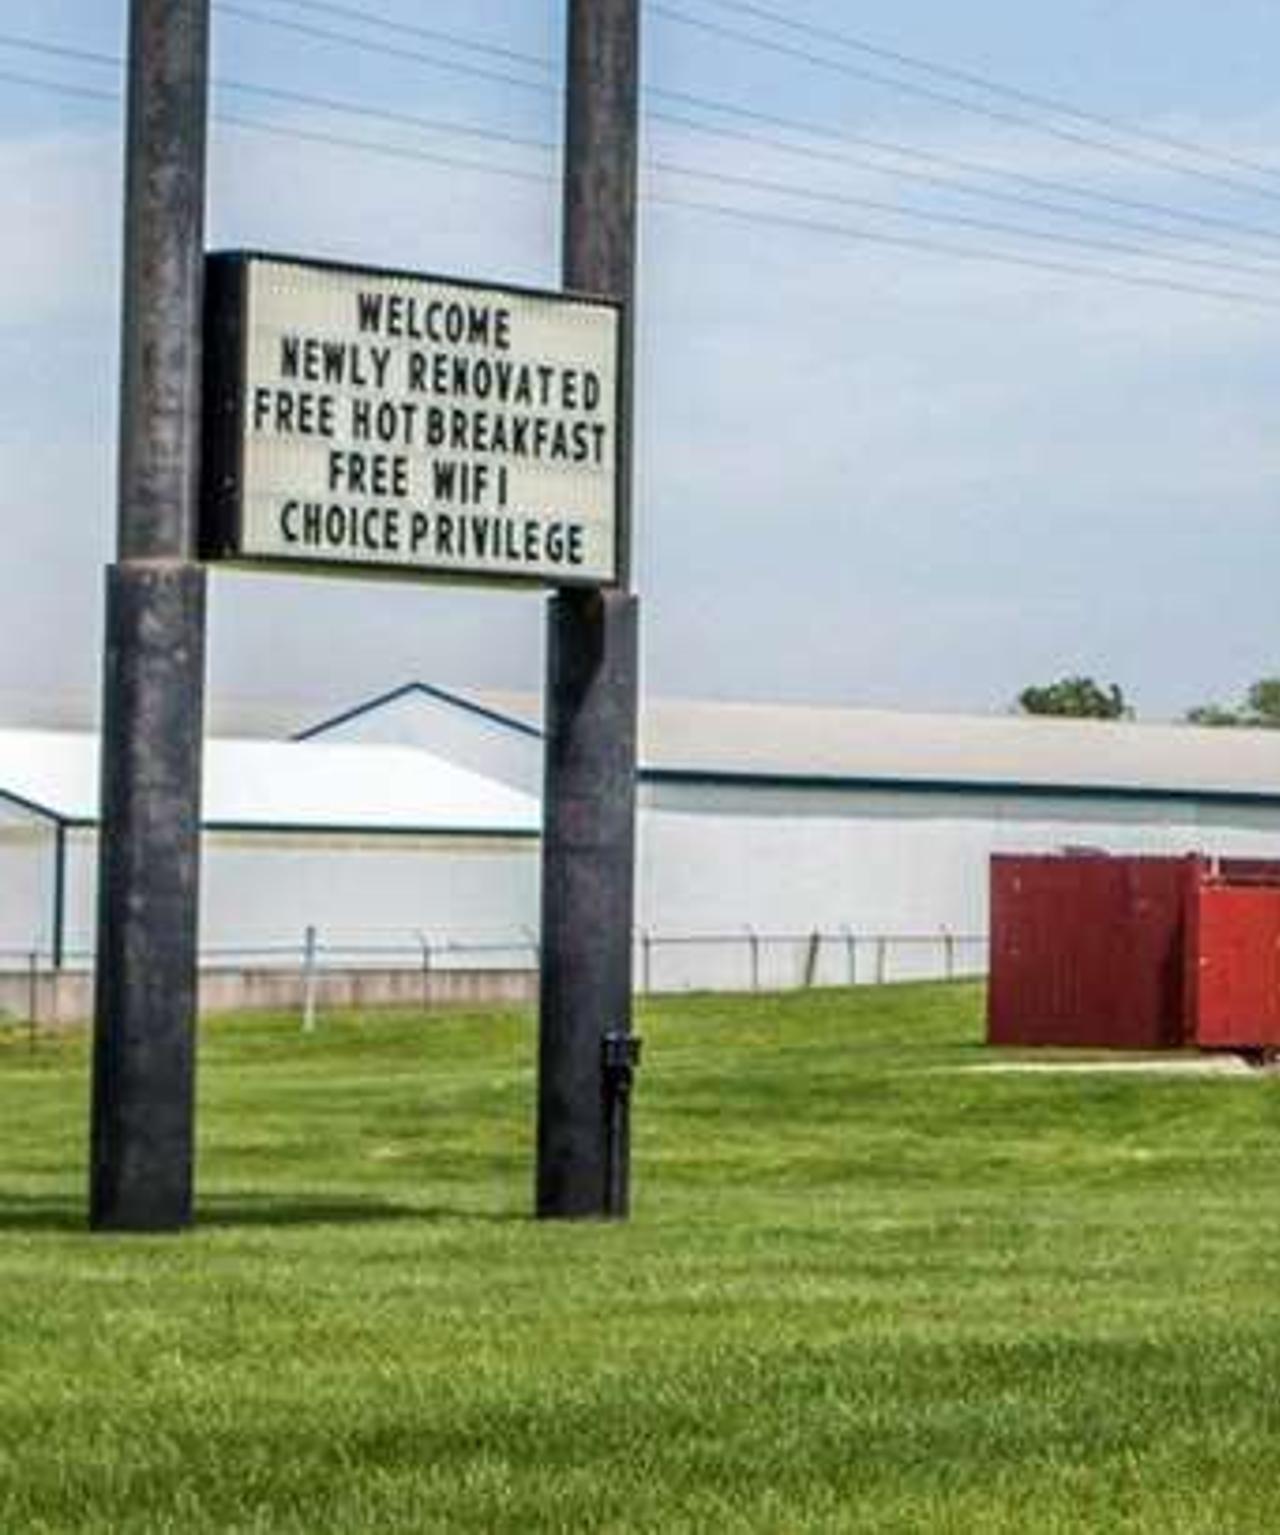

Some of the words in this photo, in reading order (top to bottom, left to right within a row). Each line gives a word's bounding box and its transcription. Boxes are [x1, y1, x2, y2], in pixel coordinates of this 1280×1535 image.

[358, 292, 511, 350] WELCOME
[281, 337, 390, 388] NEWLY
[409, 352, 600, 411] RENOVATED
[254, 387, 335, 437] FREE
[352, 401, 418, 445] HOT
[427, 406, 606, 463] BREAKFAST
[328, 450, 408, 496] FREE
[433, 460, 508, 505] WIFI
[280, 501, 398, 551] CHOICE
[410, 512, 584, 564] PRIVILEGE
